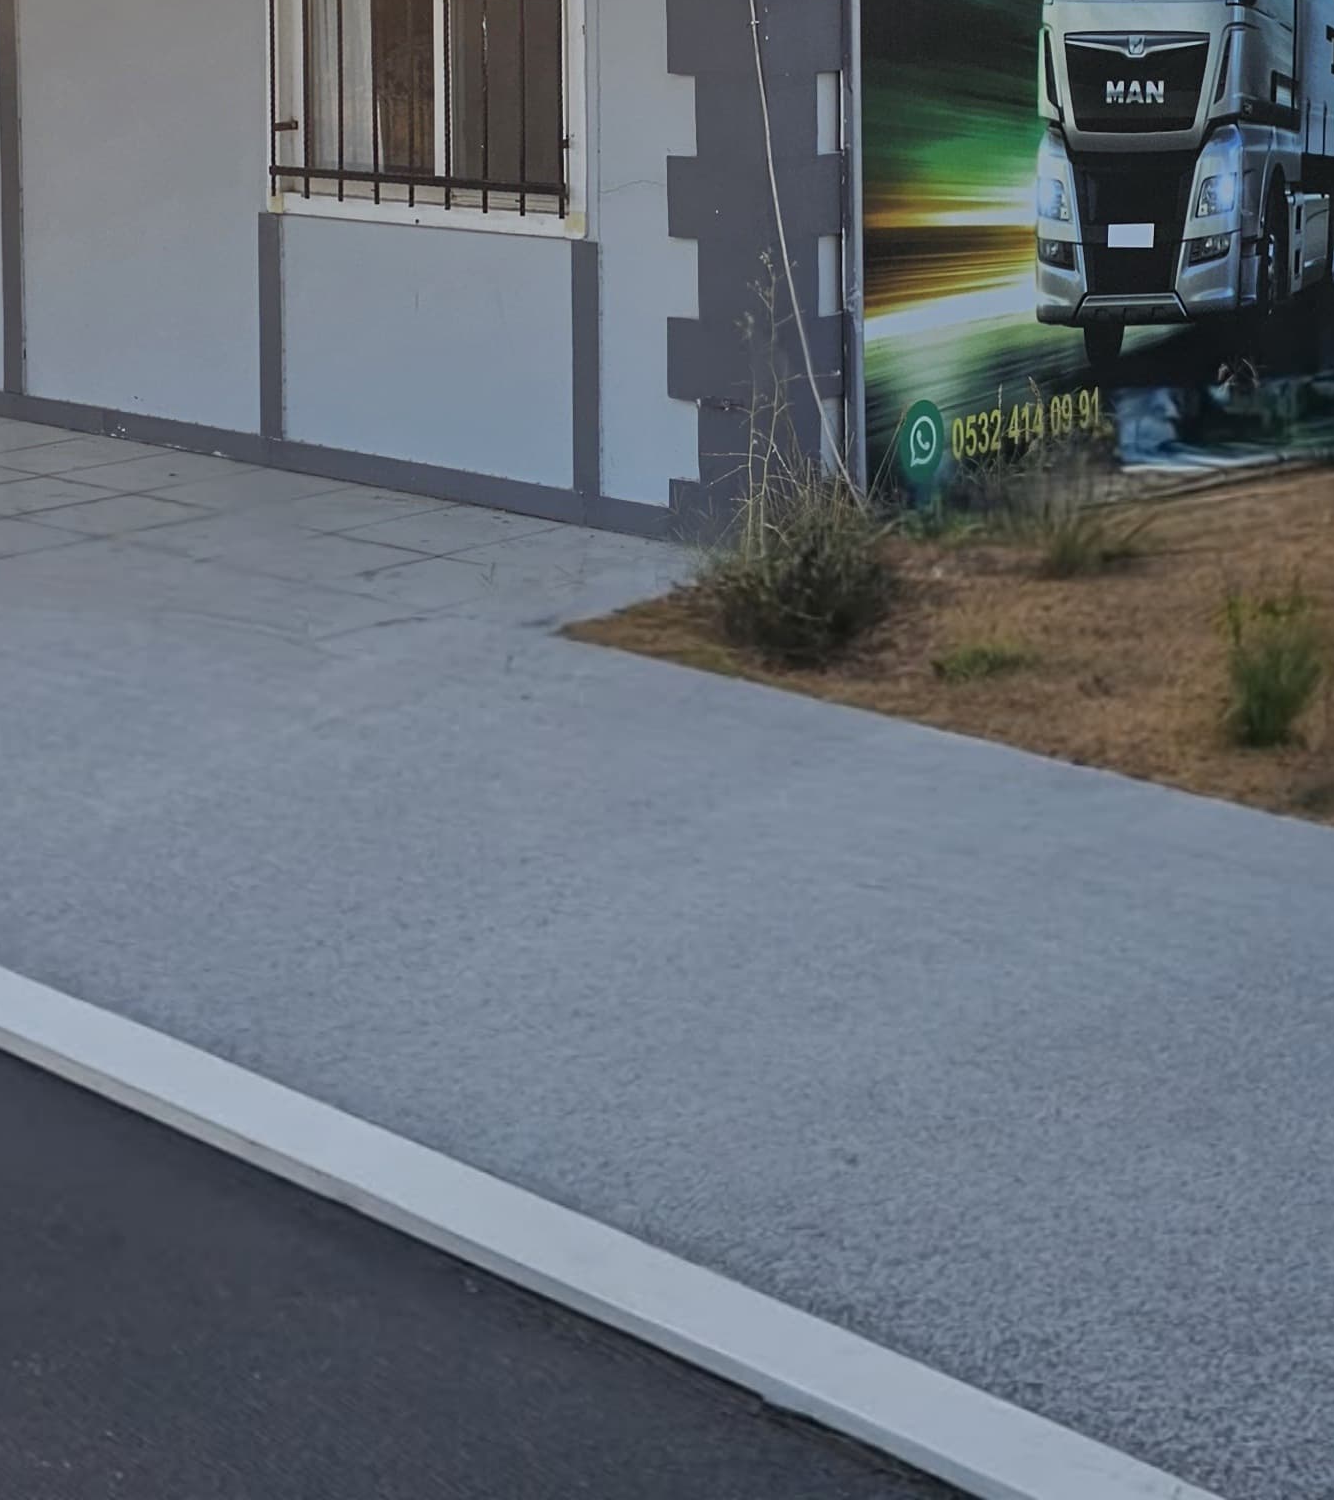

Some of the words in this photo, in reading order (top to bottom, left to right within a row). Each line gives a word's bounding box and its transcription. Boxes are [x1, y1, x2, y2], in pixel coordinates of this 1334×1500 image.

[1106, 80, 1165, 104] MAN
[952, 408, 1002, 461] 0532
[1008, 402, 1044, 445] 414
[1079, 386, 1099, 429] 91
